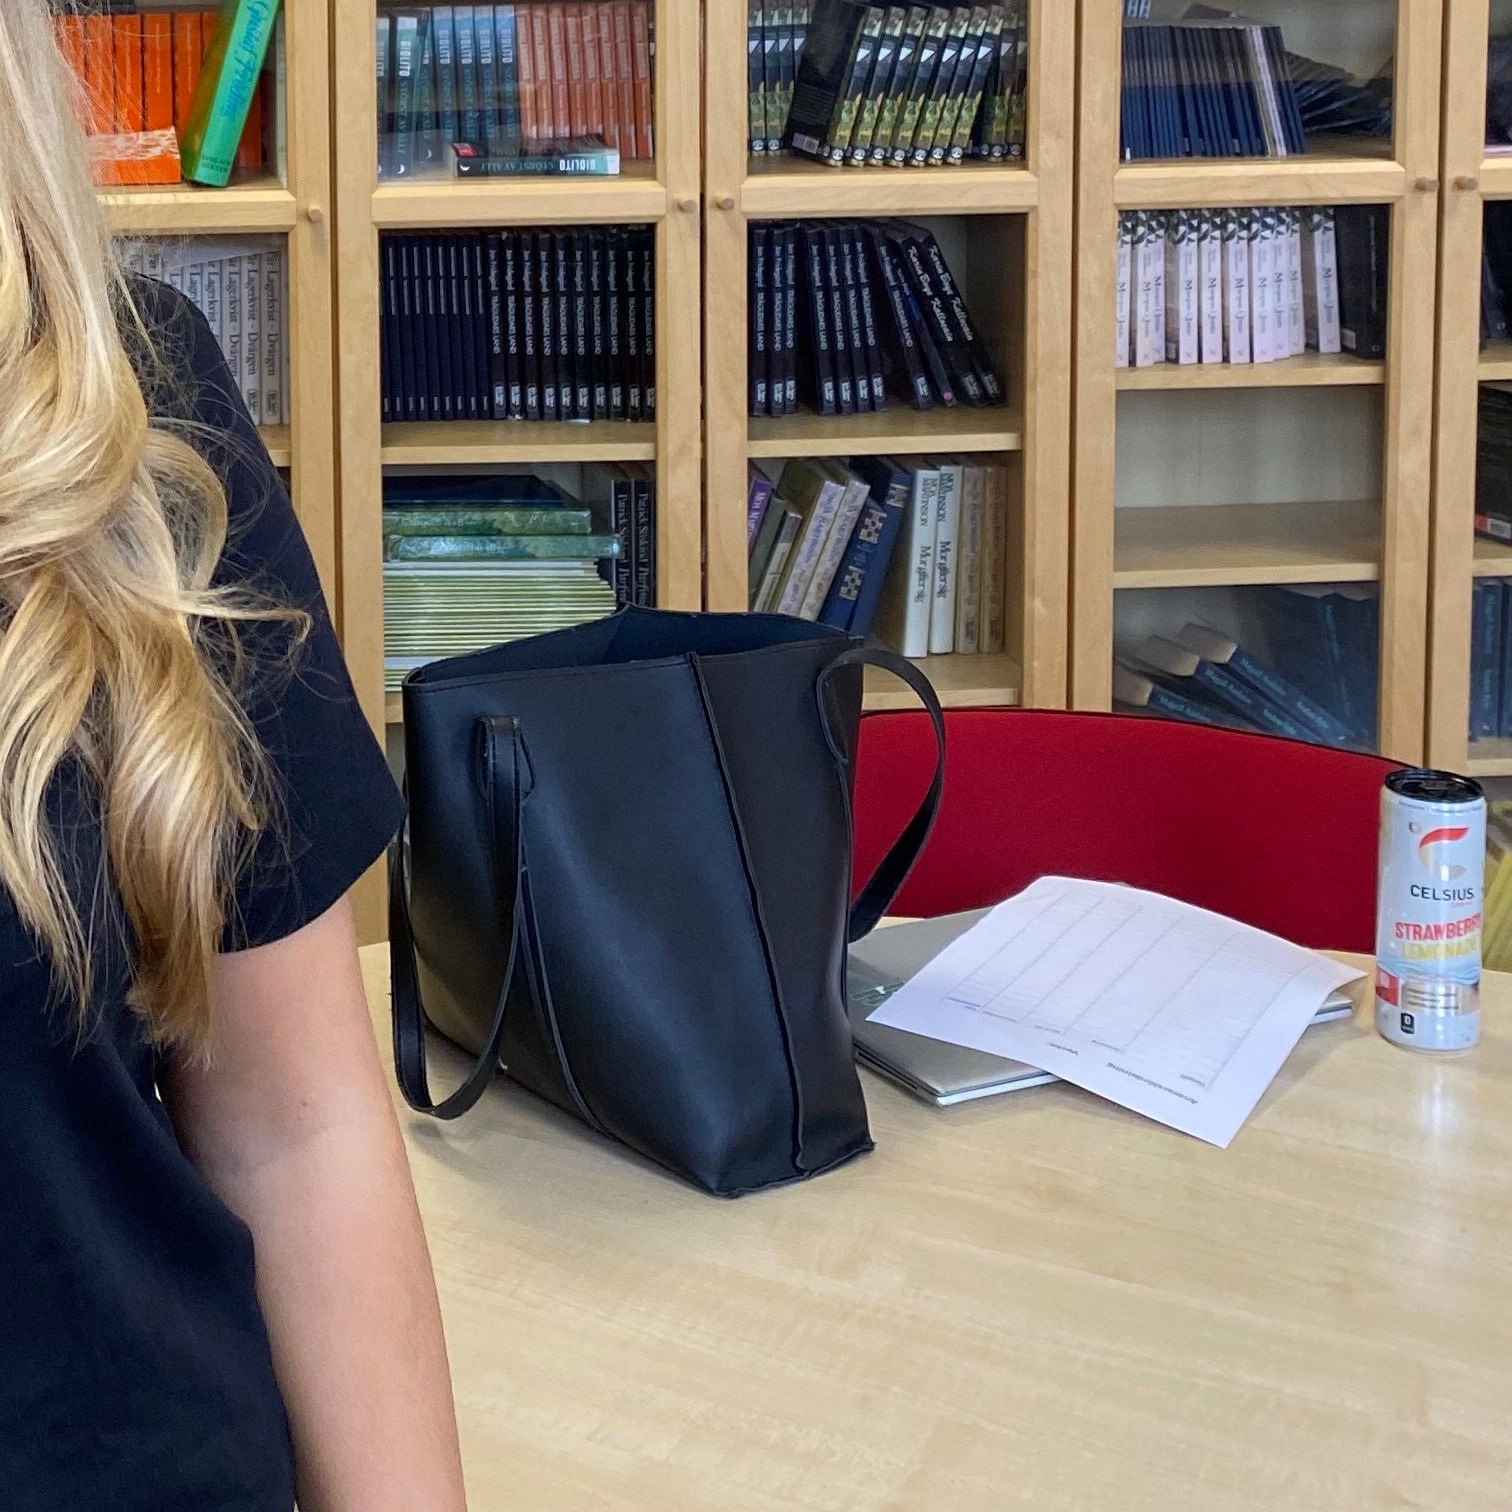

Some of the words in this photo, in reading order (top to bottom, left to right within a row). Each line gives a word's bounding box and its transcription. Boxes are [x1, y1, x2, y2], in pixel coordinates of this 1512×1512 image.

[398, 40, 411, 77] GIOLITO
[559, 159, 596, 171] GIOLITO
[244, 269, 259, 320] Lagerkvist
[264, 270, 278, 321] Lagerkvist
[786, 330, 794, 348] LAND
[819, 331, 827, 350] LAND
[836, 332, 844, 350] LAND
[852, 330, 860, 348] LAND
[866, 327, 875, 346] LAND
[903, 329, 913, 348] LAND
[265, 333, 279, 377] Dvärgen
[543, 337, 551, 356] LAND
[1410, 884, 1475, 901] CELSIUS
